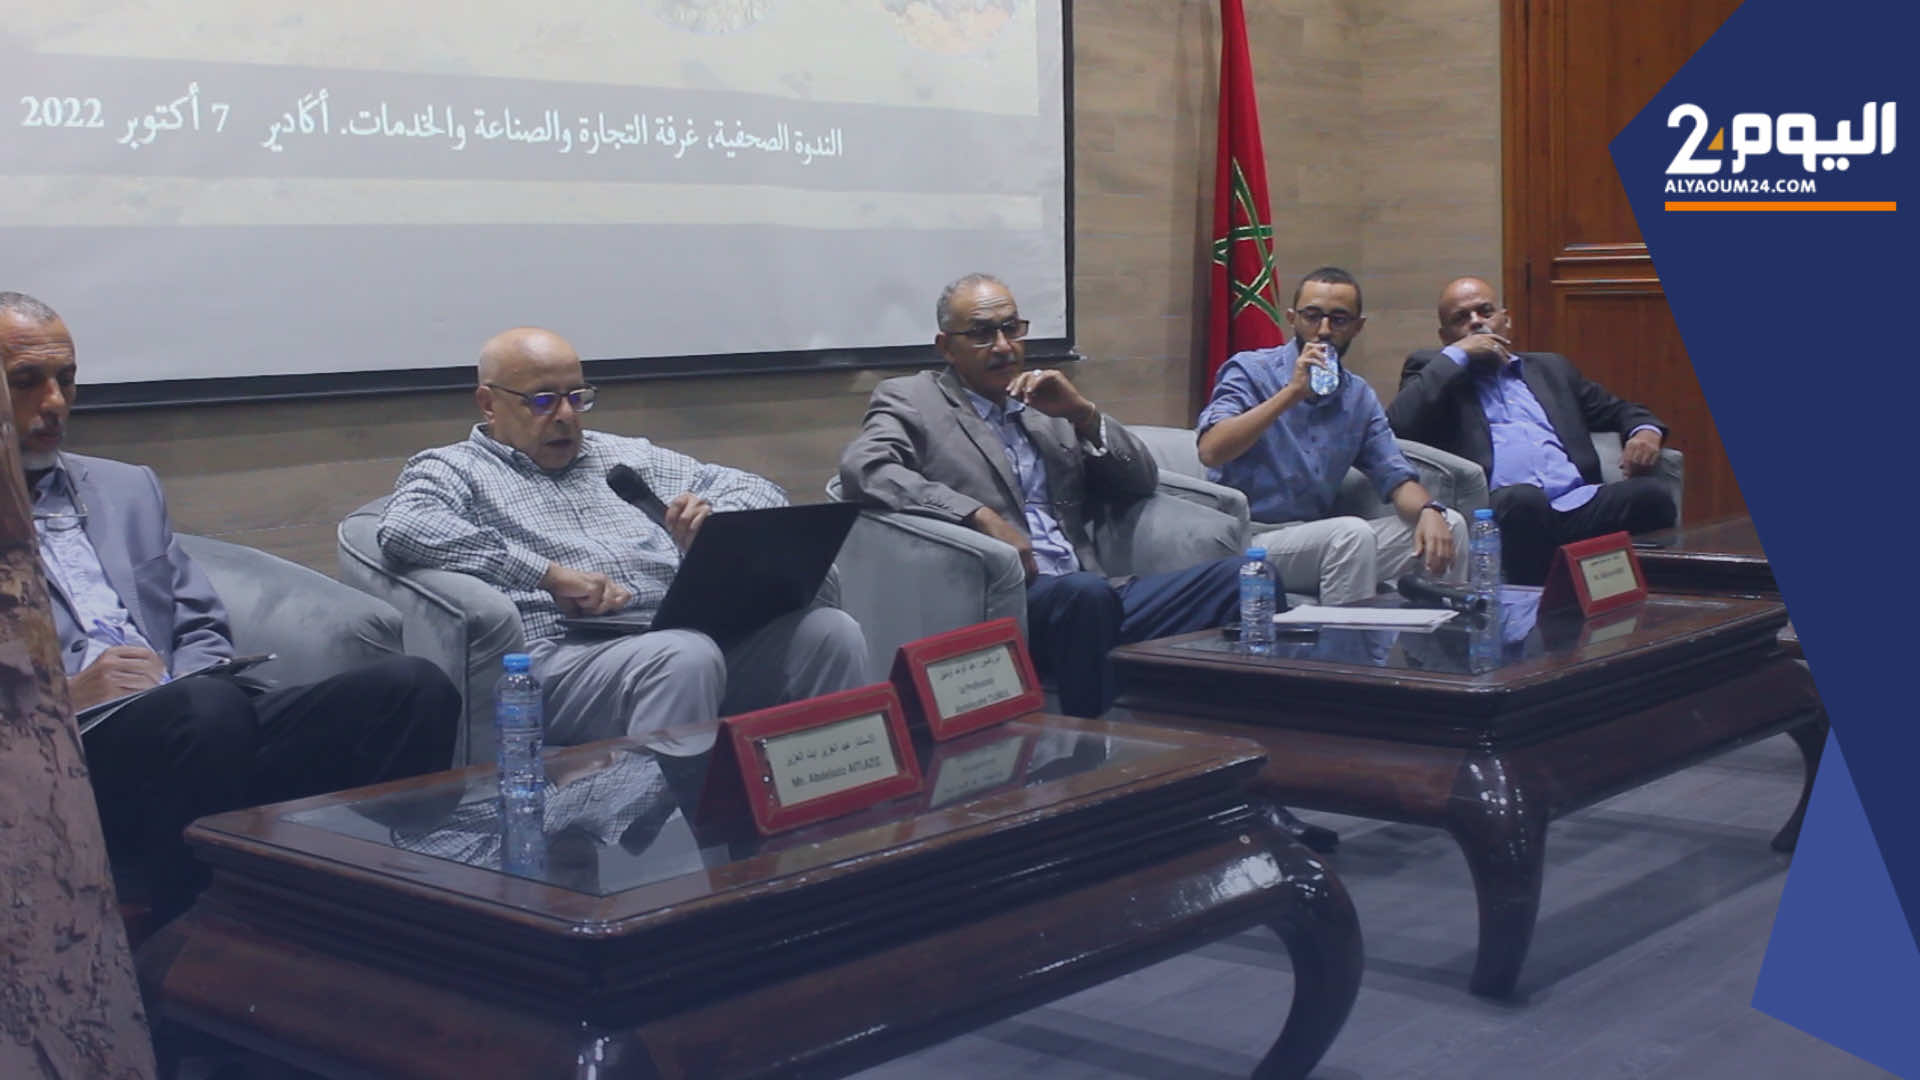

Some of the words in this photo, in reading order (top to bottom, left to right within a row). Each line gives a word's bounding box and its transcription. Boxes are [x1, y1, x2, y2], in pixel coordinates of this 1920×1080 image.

[20, 95, 105, 128] 2022
[117, 81, 199, 150] أكتوبر
[211, 103, 230, 133] 7
[473, 107, 572, 153] والصناعة
[578, 112, 648, 155] التجارة
[655, 115, 699, 159] غرفة
[794, 128, 843, 165] الندوة
